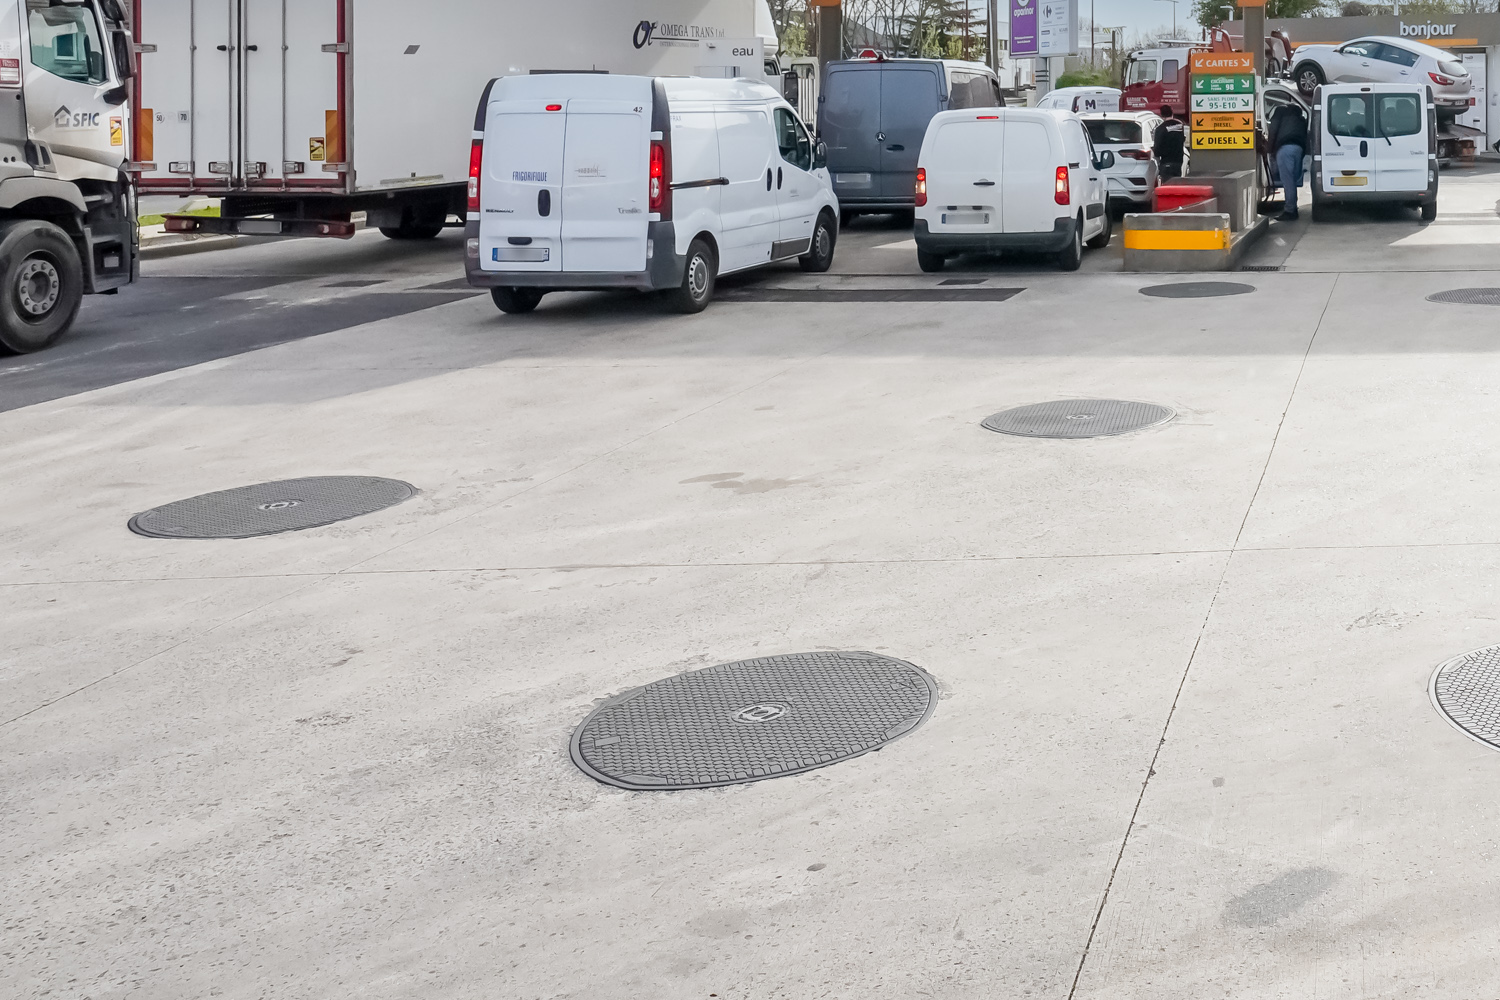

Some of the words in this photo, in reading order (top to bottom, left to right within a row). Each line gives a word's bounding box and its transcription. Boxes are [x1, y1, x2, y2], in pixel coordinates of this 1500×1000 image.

[661, 24, 688, 37] OMEGA
[691, 26, 714, 37] TRANS
[1400, 20, 1456, 39] bonjour
[732, 48, 754, 56] eau
[73, 113, 100, 127] SFIC
[512, 171, 547, 181] FRIGORIFIQUE
